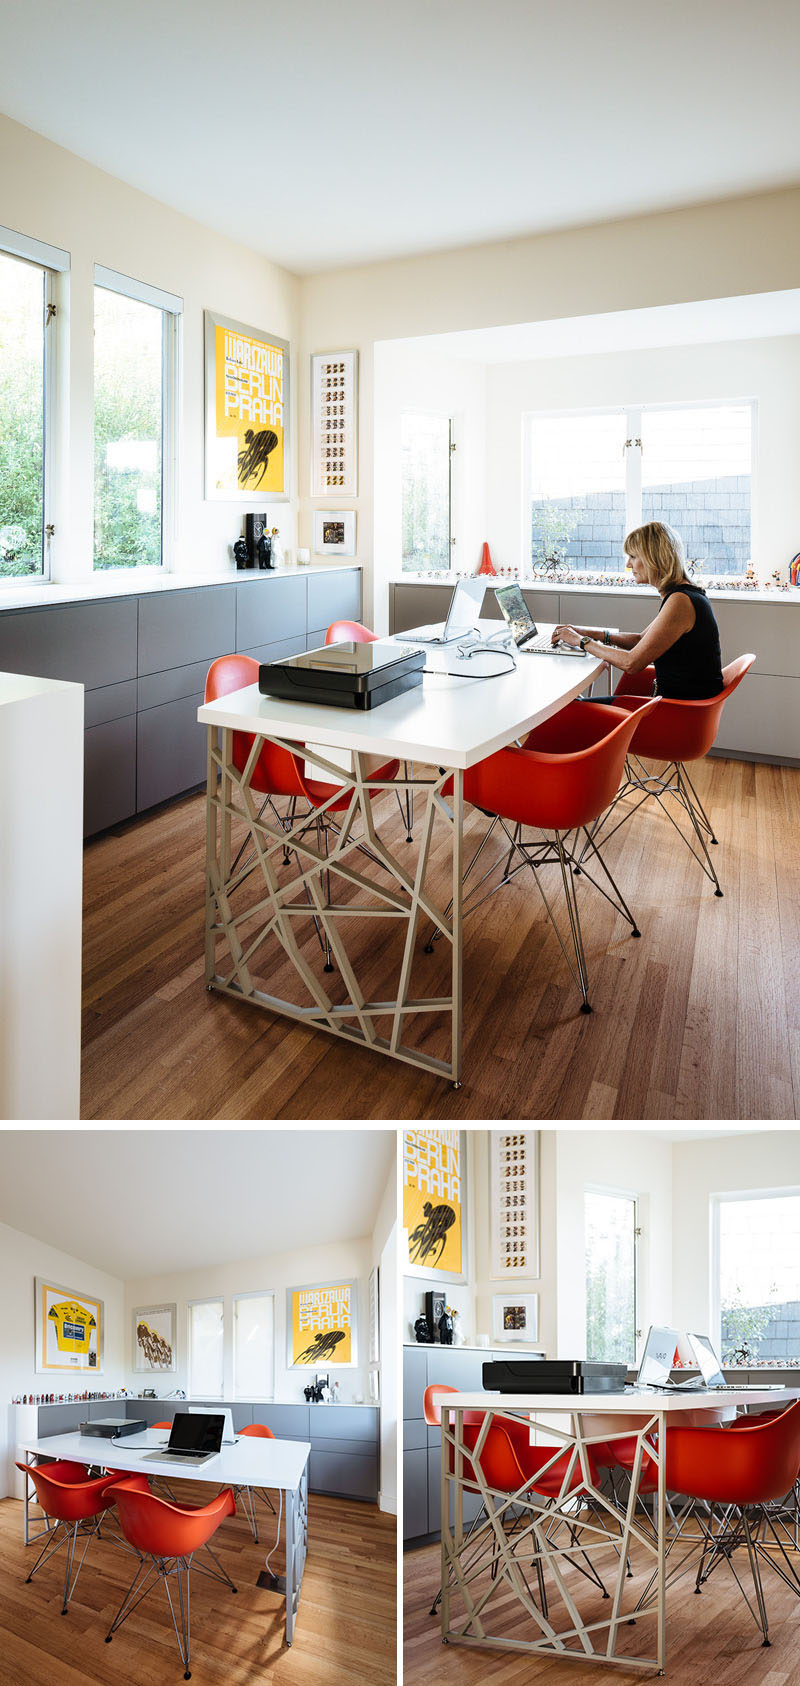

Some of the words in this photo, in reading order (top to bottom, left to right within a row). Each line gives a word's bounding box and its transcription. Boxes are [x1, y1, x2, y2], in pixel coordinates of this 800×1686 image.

[224, 363, 283, 404] BERLIN
[224, 393, 284, 428] PRAHA
[403, 1130, 461, 1178] BERLIN
[403, 1159, 461, 1204] PRAHA
[299, 1302, 351, 1319] BERLIN
[299, 1315, 351, 1331] PRAHA
